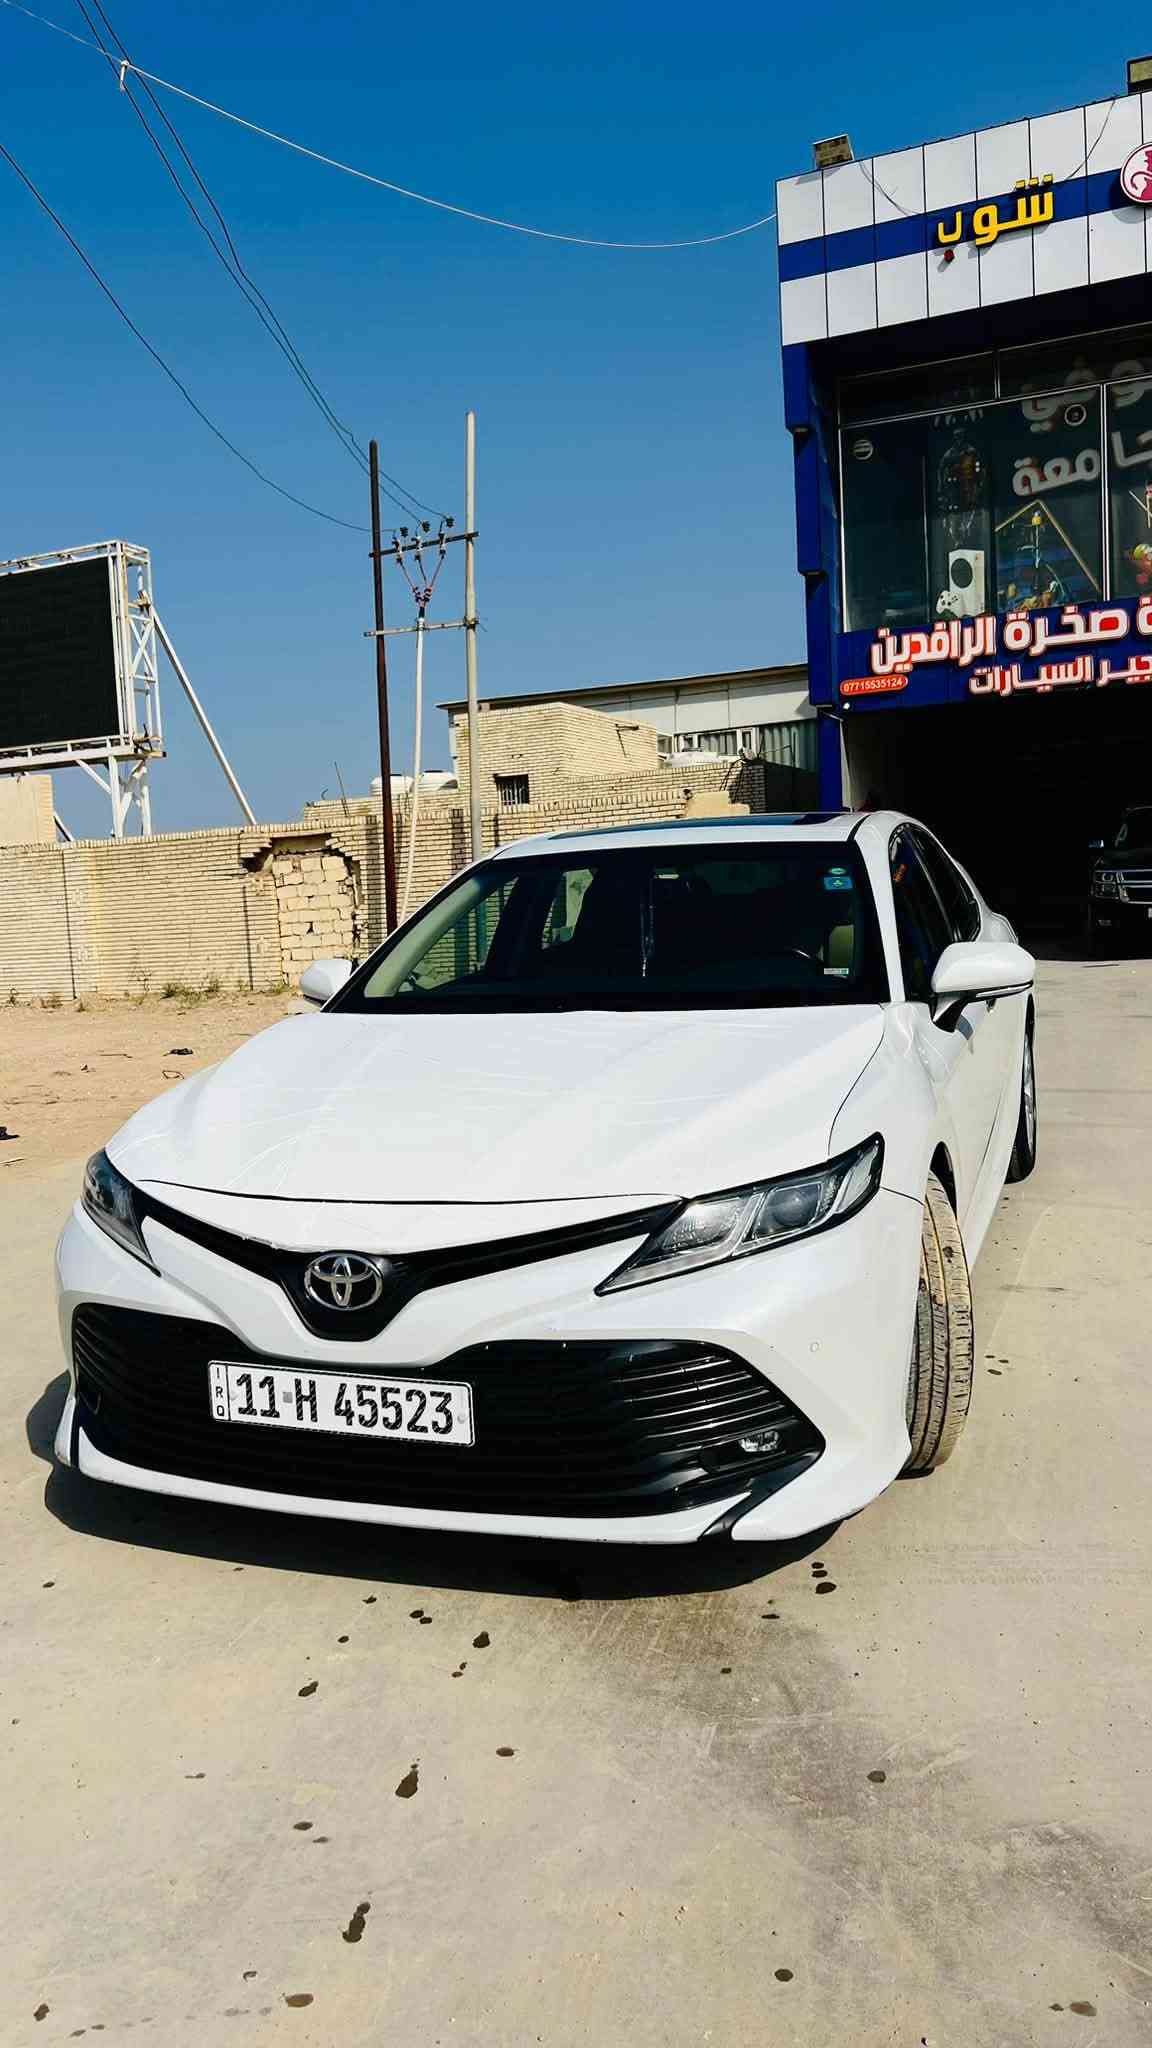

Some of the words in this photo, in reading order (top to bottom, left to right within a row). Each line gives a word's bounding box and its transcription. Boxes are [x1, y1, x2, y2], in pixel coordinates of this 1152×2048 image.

[870, 616, 998, 674] الرافدين
[1003, 605, 1130, 656] صخرة
[968, 656, 1094, 697] السيارات
[236, 1373, 280, 1418] 11
[294, 1378, 318, 1422] H
[334, 1382, 453, 1435] 45523
